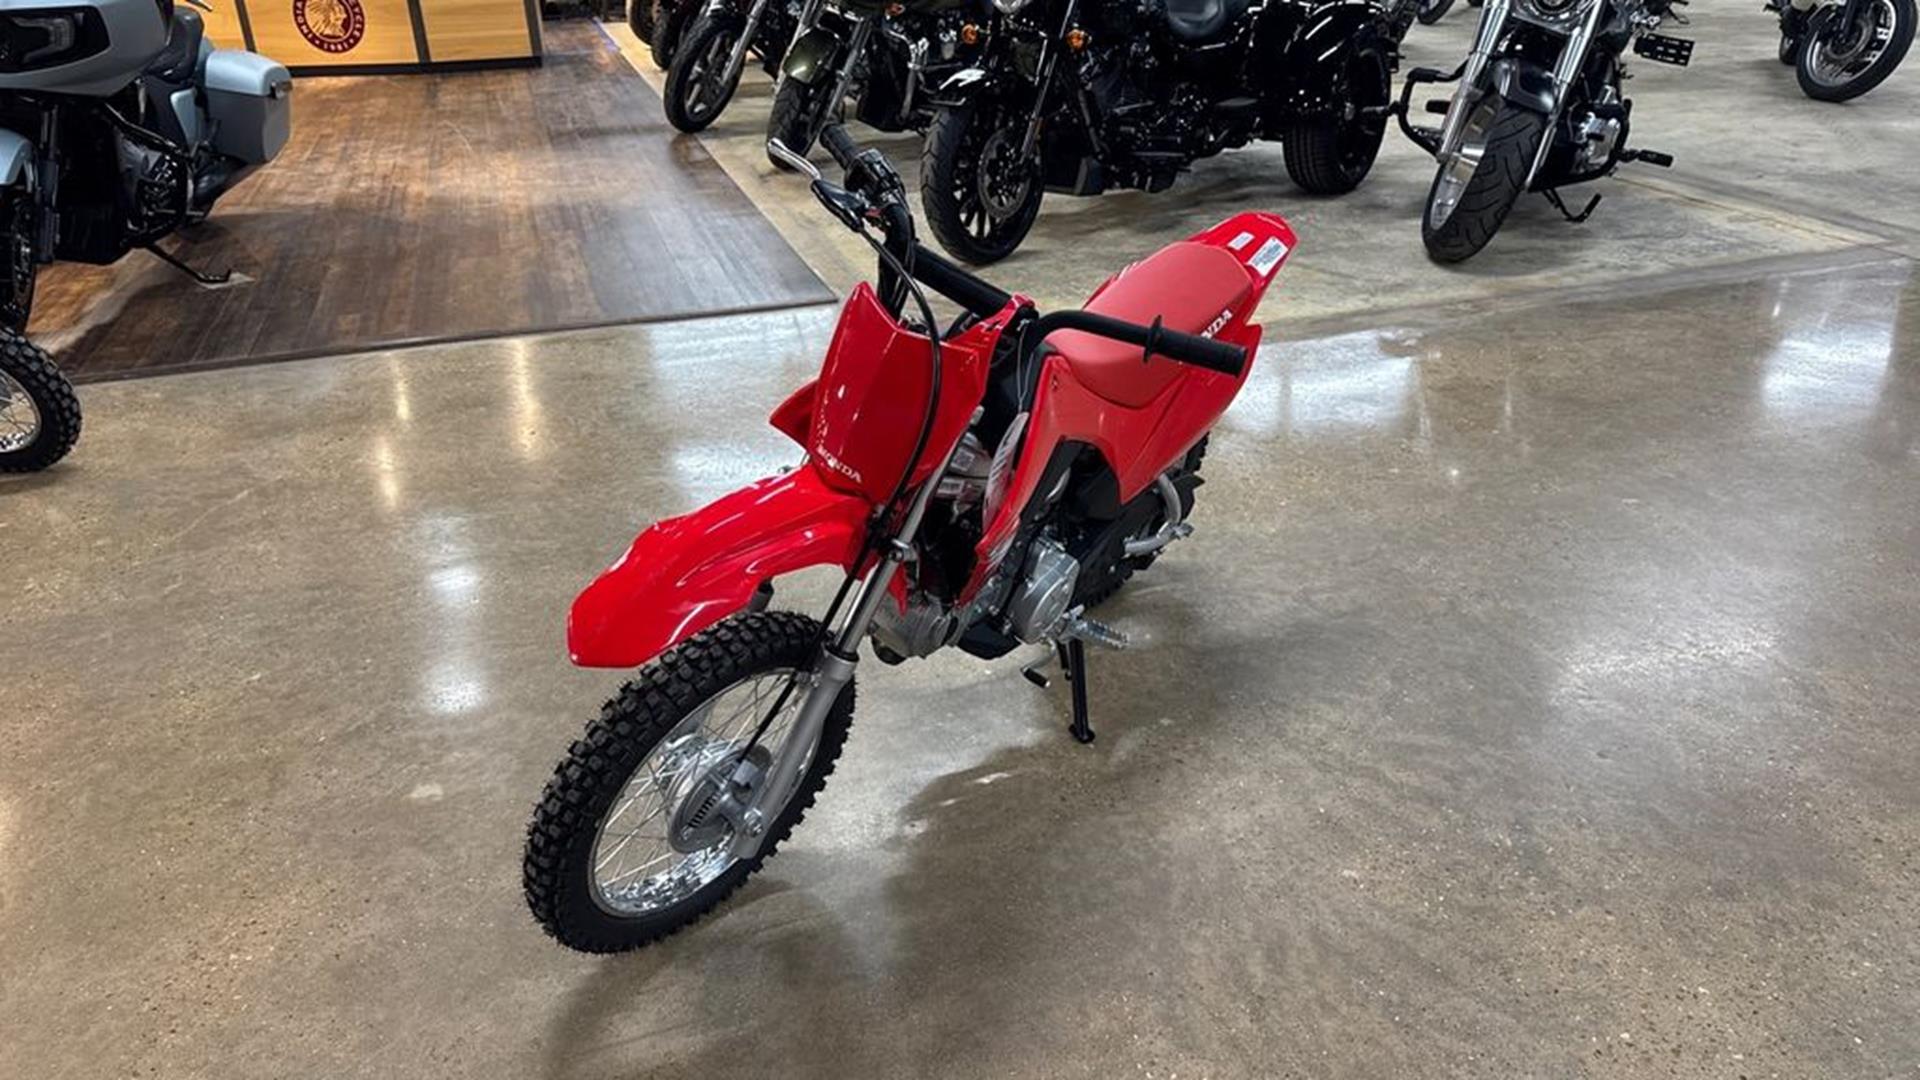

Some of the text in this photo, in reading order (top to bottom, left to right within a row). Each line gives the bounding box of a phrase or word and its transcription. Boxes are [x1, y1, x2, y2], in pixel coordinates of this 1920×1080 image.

[295, 0, 313, 38] INDIA
[1200, 309, 1233, 339] NDA
[817, 445, 862, 483] HONDA
